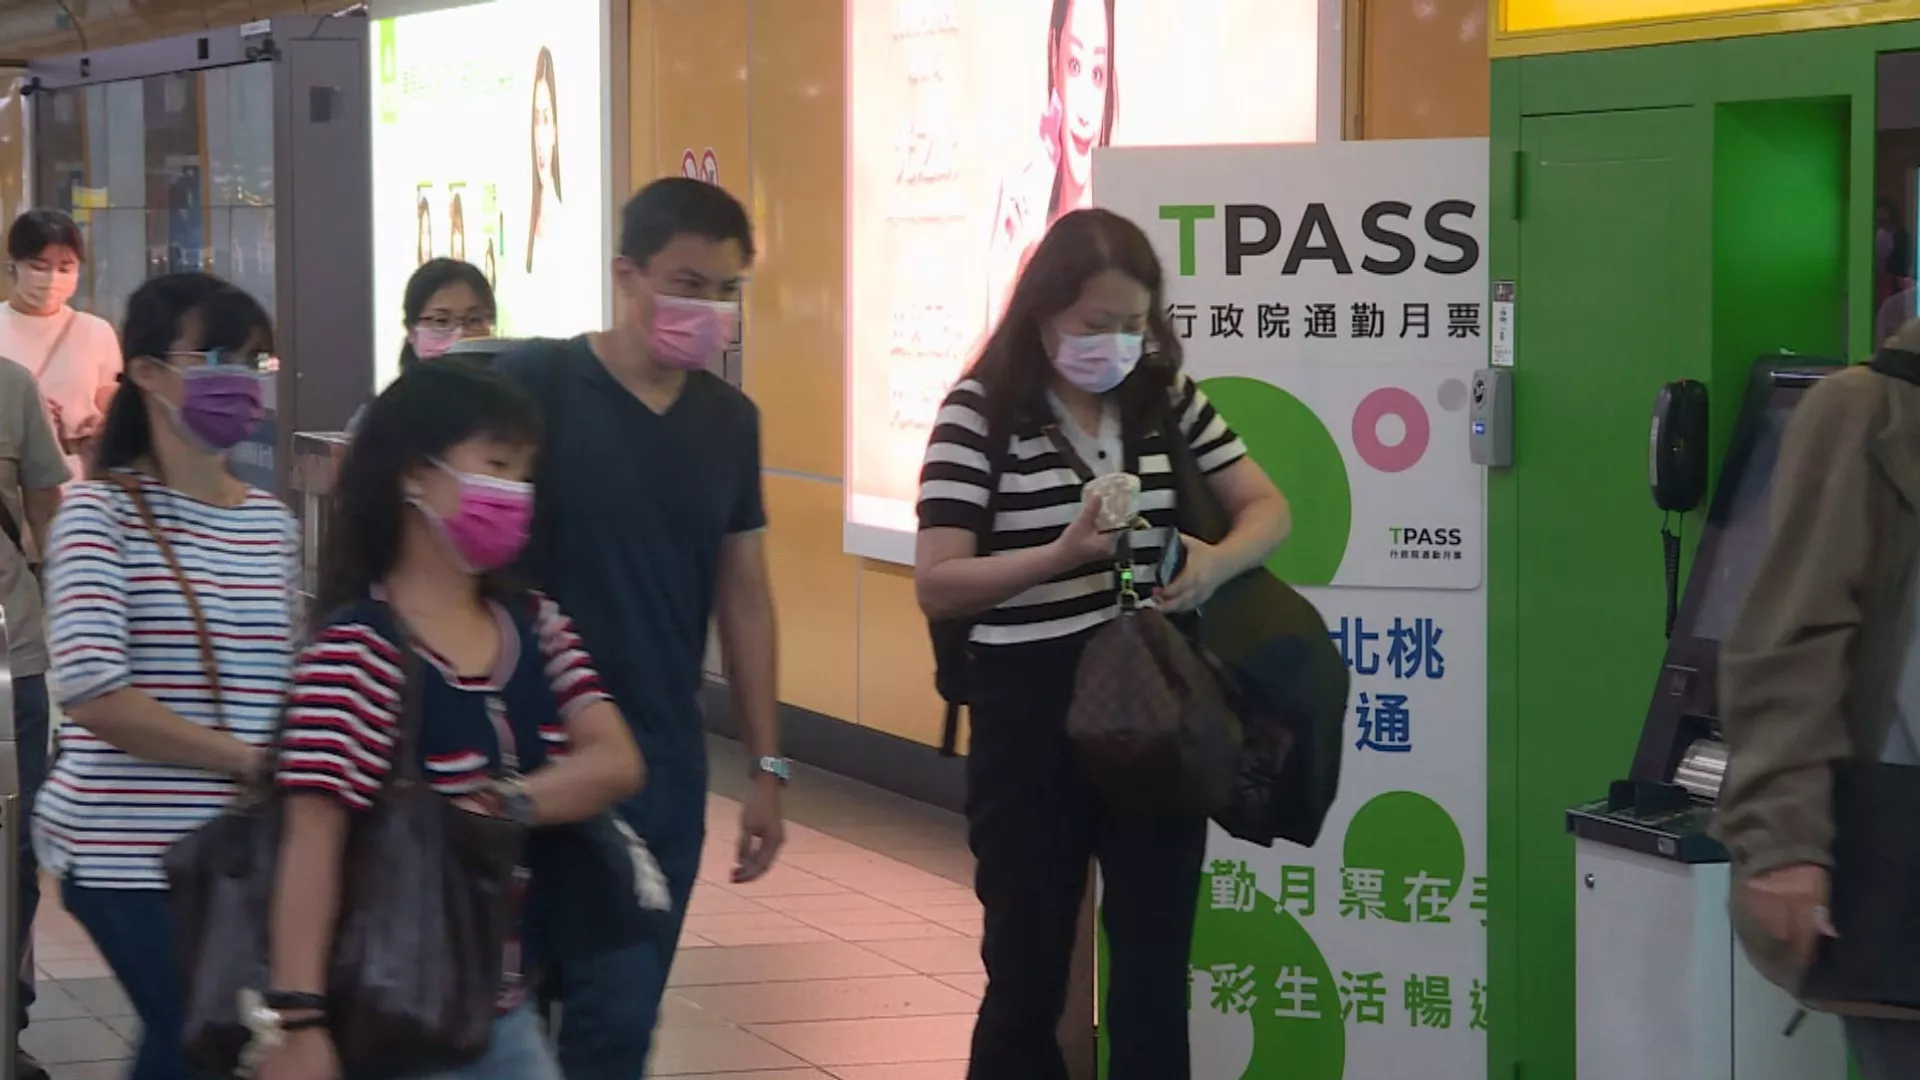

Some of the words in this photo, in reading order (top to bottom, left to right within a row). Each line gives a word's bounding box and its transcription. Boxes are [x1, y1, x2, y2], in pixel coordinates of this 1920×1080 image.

[1159, 200, 1480, 276] TPASS
[1167, 303, 1481, 339] 行政院通勤月票
[1389, 527, 1462, 545] TPASS
[1328, 616, 1445, 679] 北桃
[1188, 963, 1487, 1031] 彩生活暢
